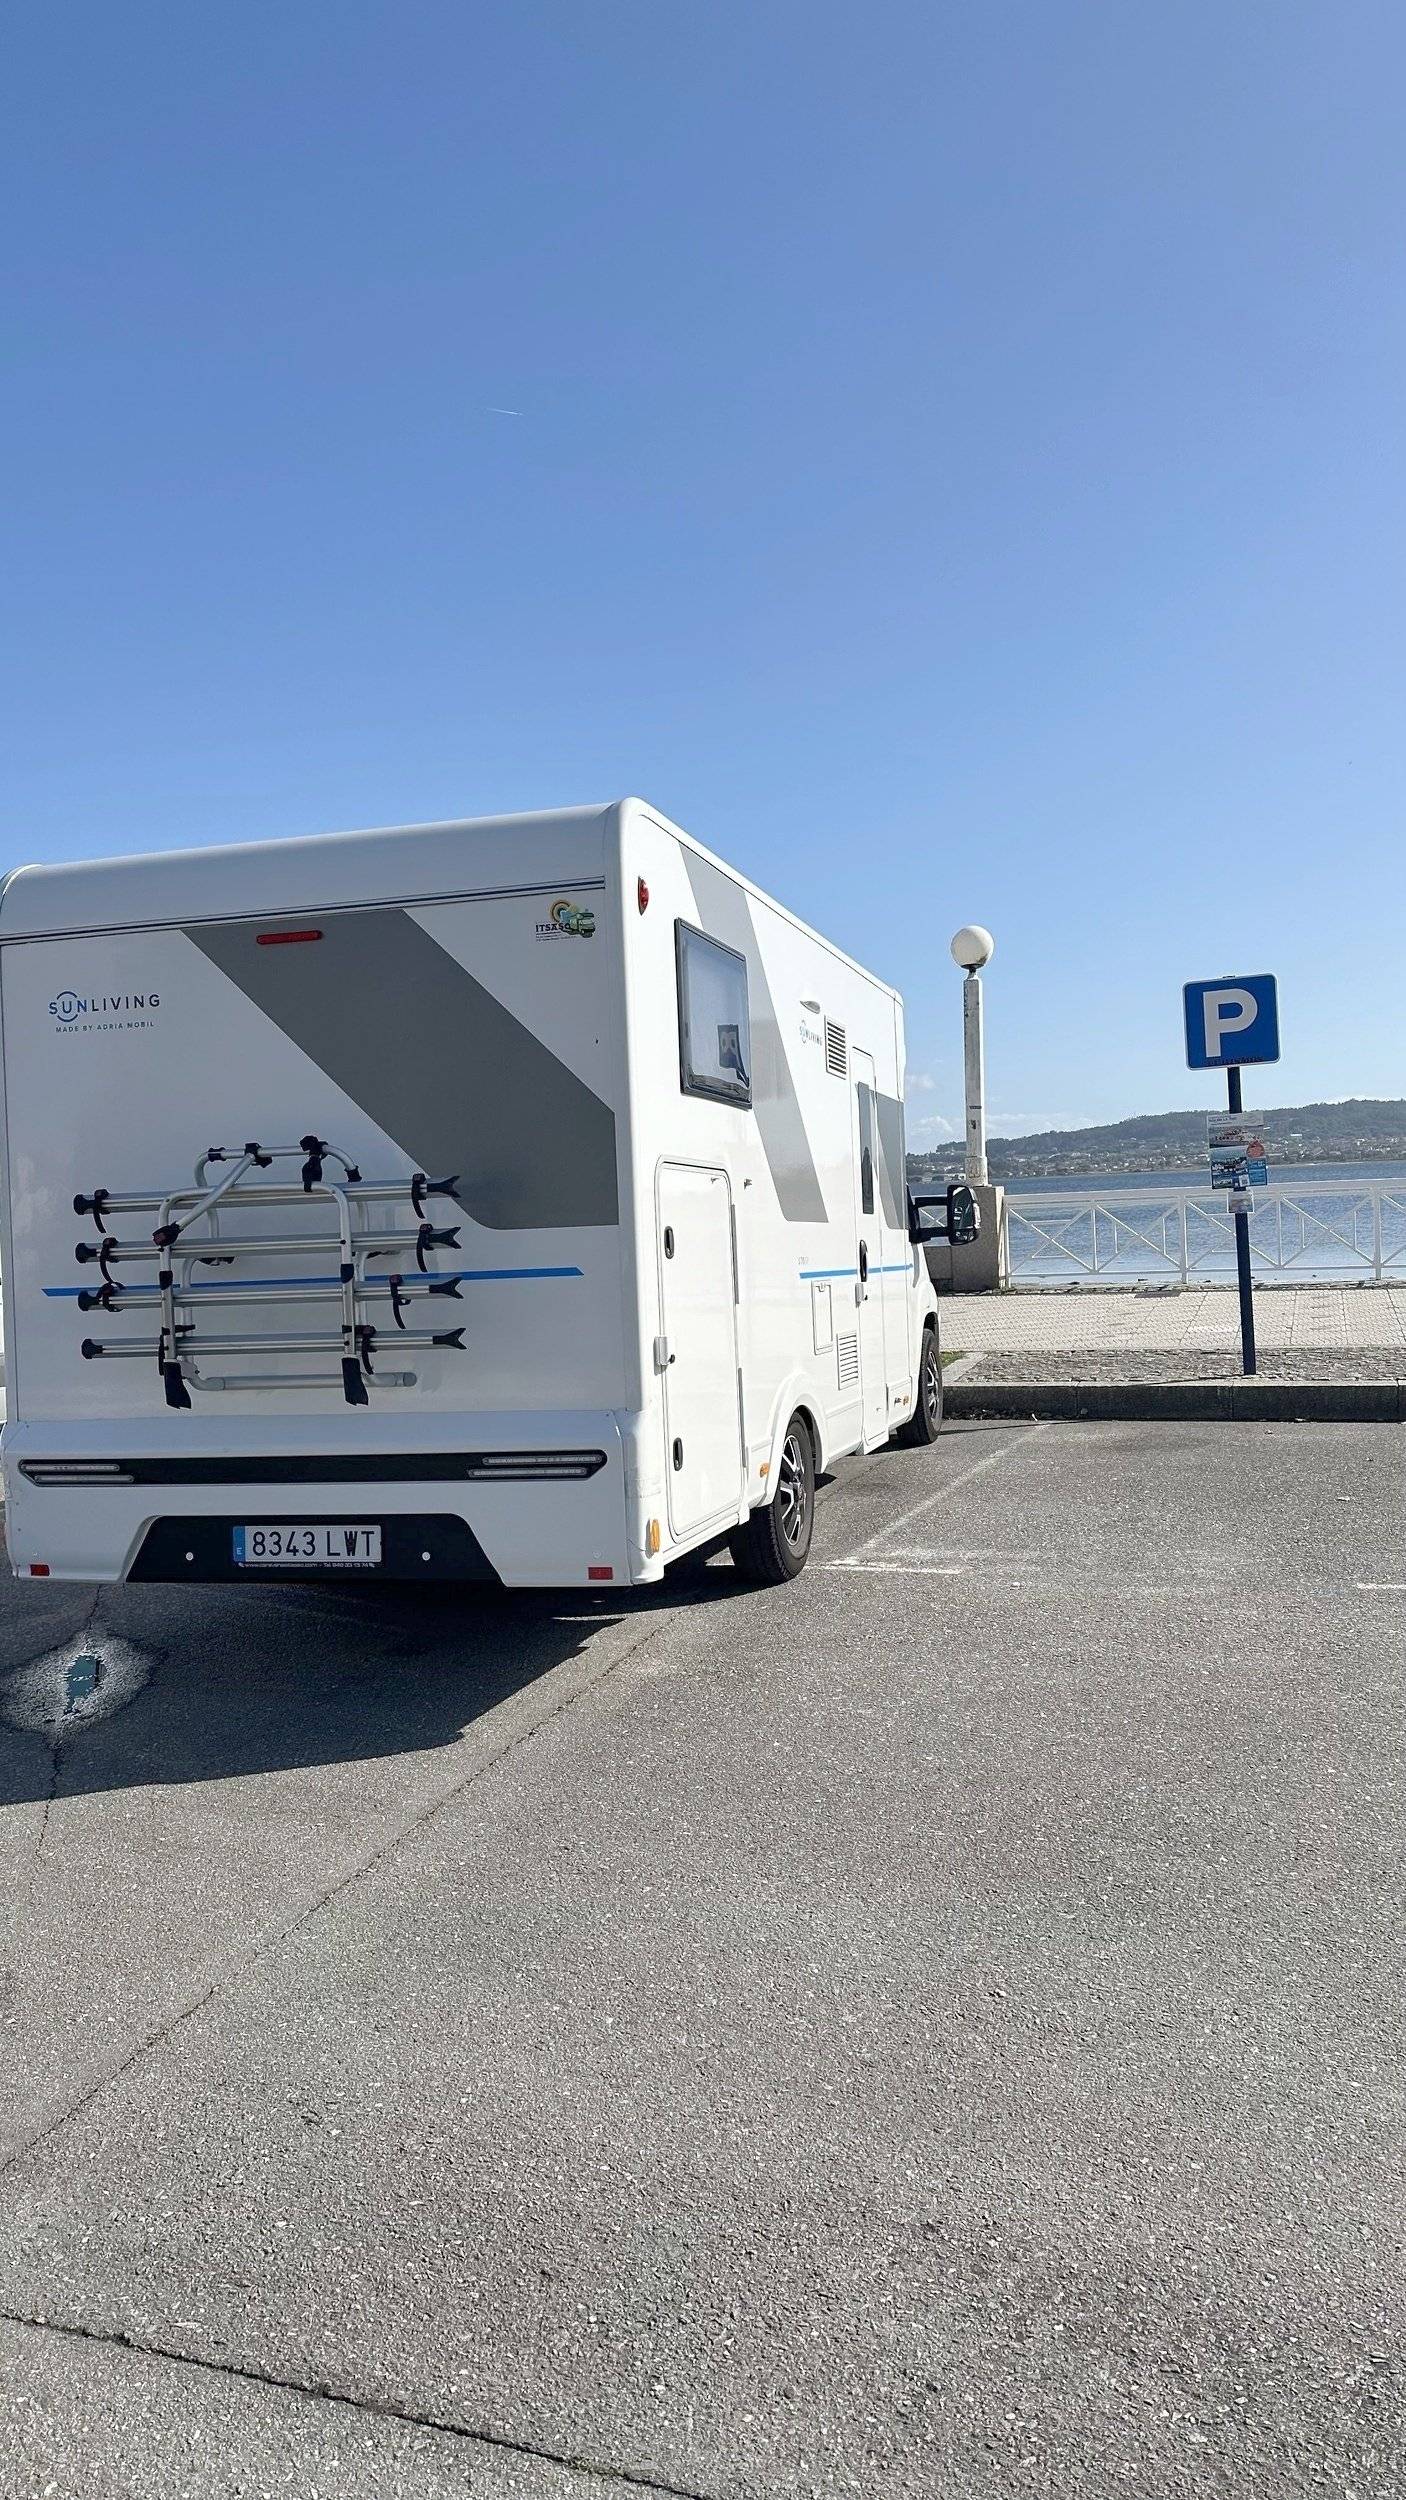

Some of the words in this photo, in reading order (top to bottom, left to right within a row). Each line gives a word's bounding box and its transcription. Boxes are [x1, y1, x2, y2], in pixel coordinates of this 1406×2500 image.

[49, 992, 160, 1019] SUNLIVING
[97, 1022, 123, 1030] ADRIA
[127, 1021, 154, 1029] MOBIL
[1203, 988, 1258, 1058] P
[236, 1547, 243, 1555] E
[252, 1531, 316, 1556] 8343
[326, 1530, 375, 1557] LWT
